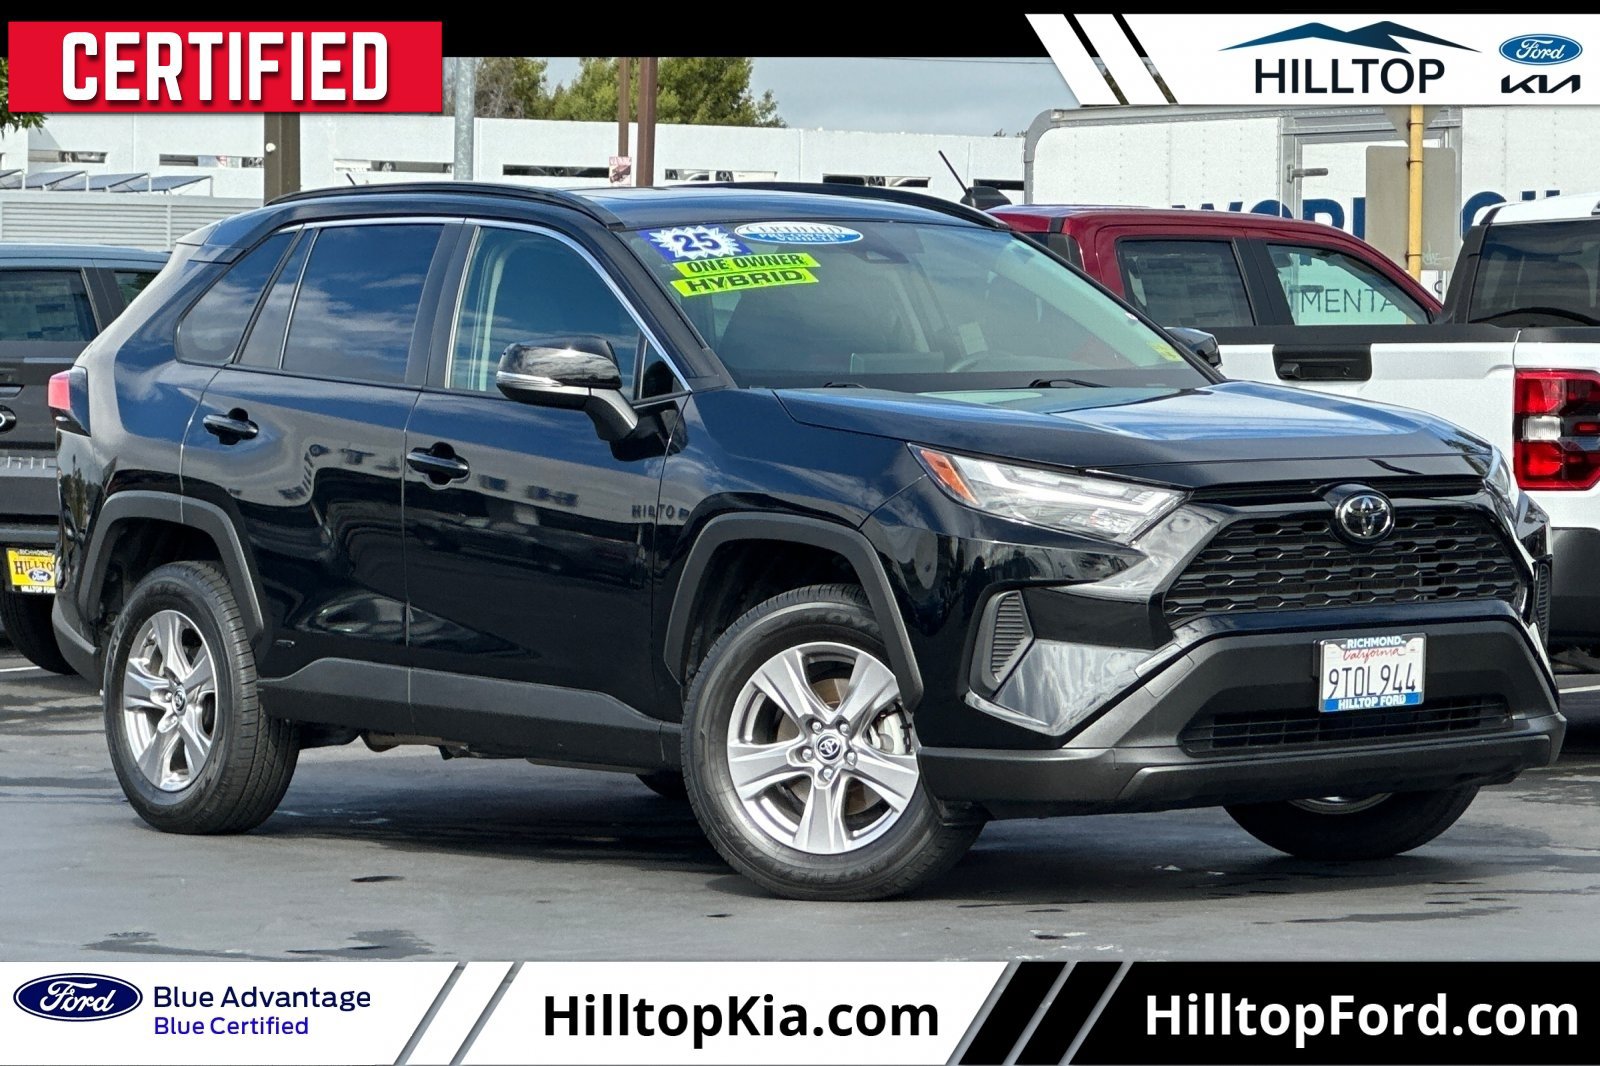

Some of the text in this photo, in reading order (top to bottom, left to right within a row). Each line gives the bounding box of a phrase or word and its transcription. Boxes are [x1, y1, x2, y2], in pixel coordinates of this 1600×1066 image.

[672, 232, 722, 252] 25
[688, 254, 804, 273] ONE OWNER
[686, 270, 804, 292] HYBRID
[13, 560, 55, 575] HILLTO
[1347, 635, 1402, 649] RICHMOND
[1342, 647, 1407, 664] California
[1338, 694, 1407, 711] HILLTOP FORD
